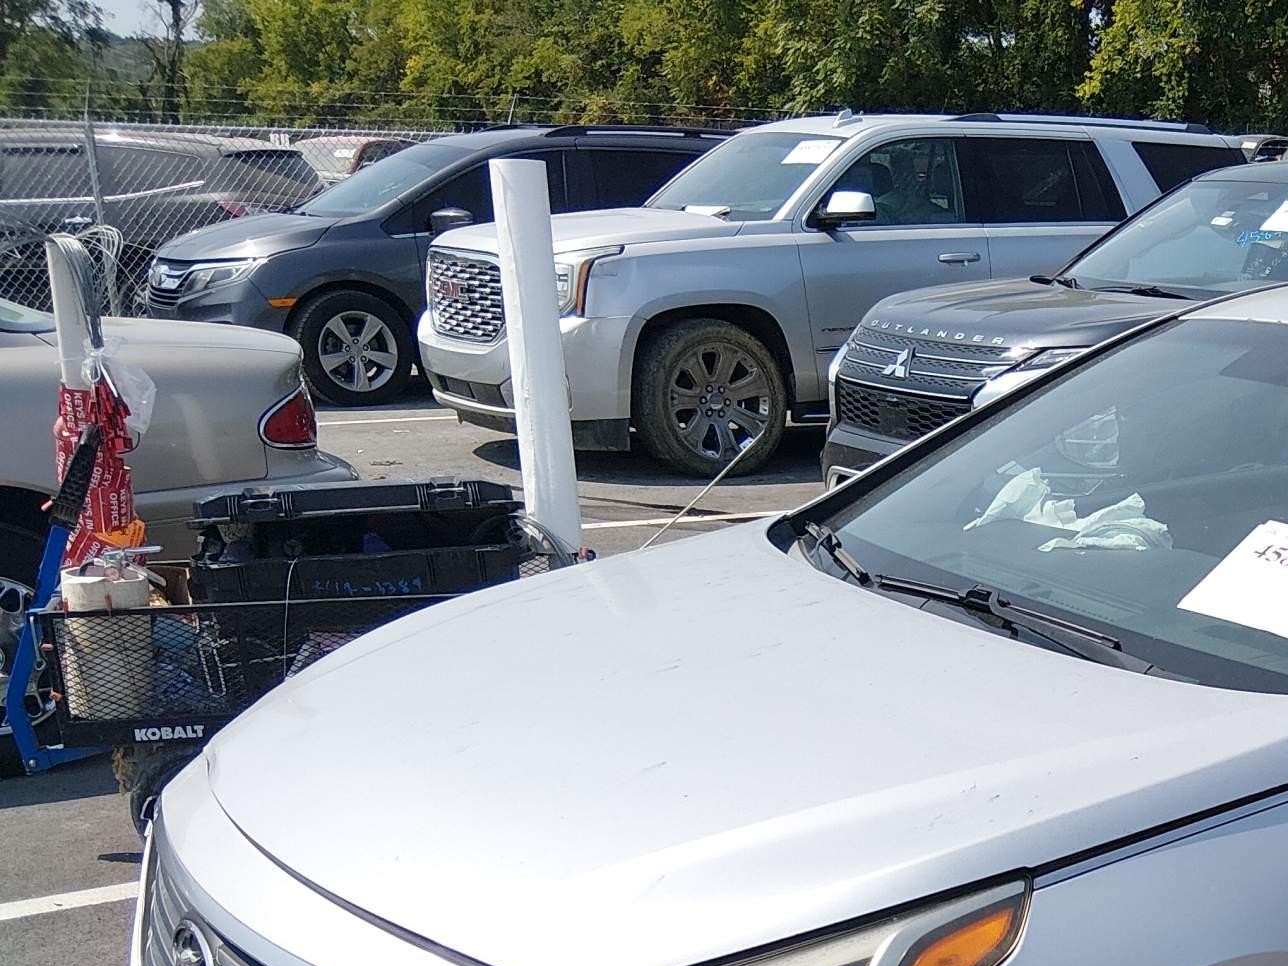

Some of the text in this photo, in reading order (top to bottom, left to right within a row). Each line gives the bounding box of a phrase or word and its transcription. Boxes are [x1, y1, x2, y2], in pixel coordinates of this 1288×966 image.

[871, 320, 1006, 345] OUTLANDER
[109, 493, 120, 527] OFFICE
[134, 725, 204, 742] KOBALT
